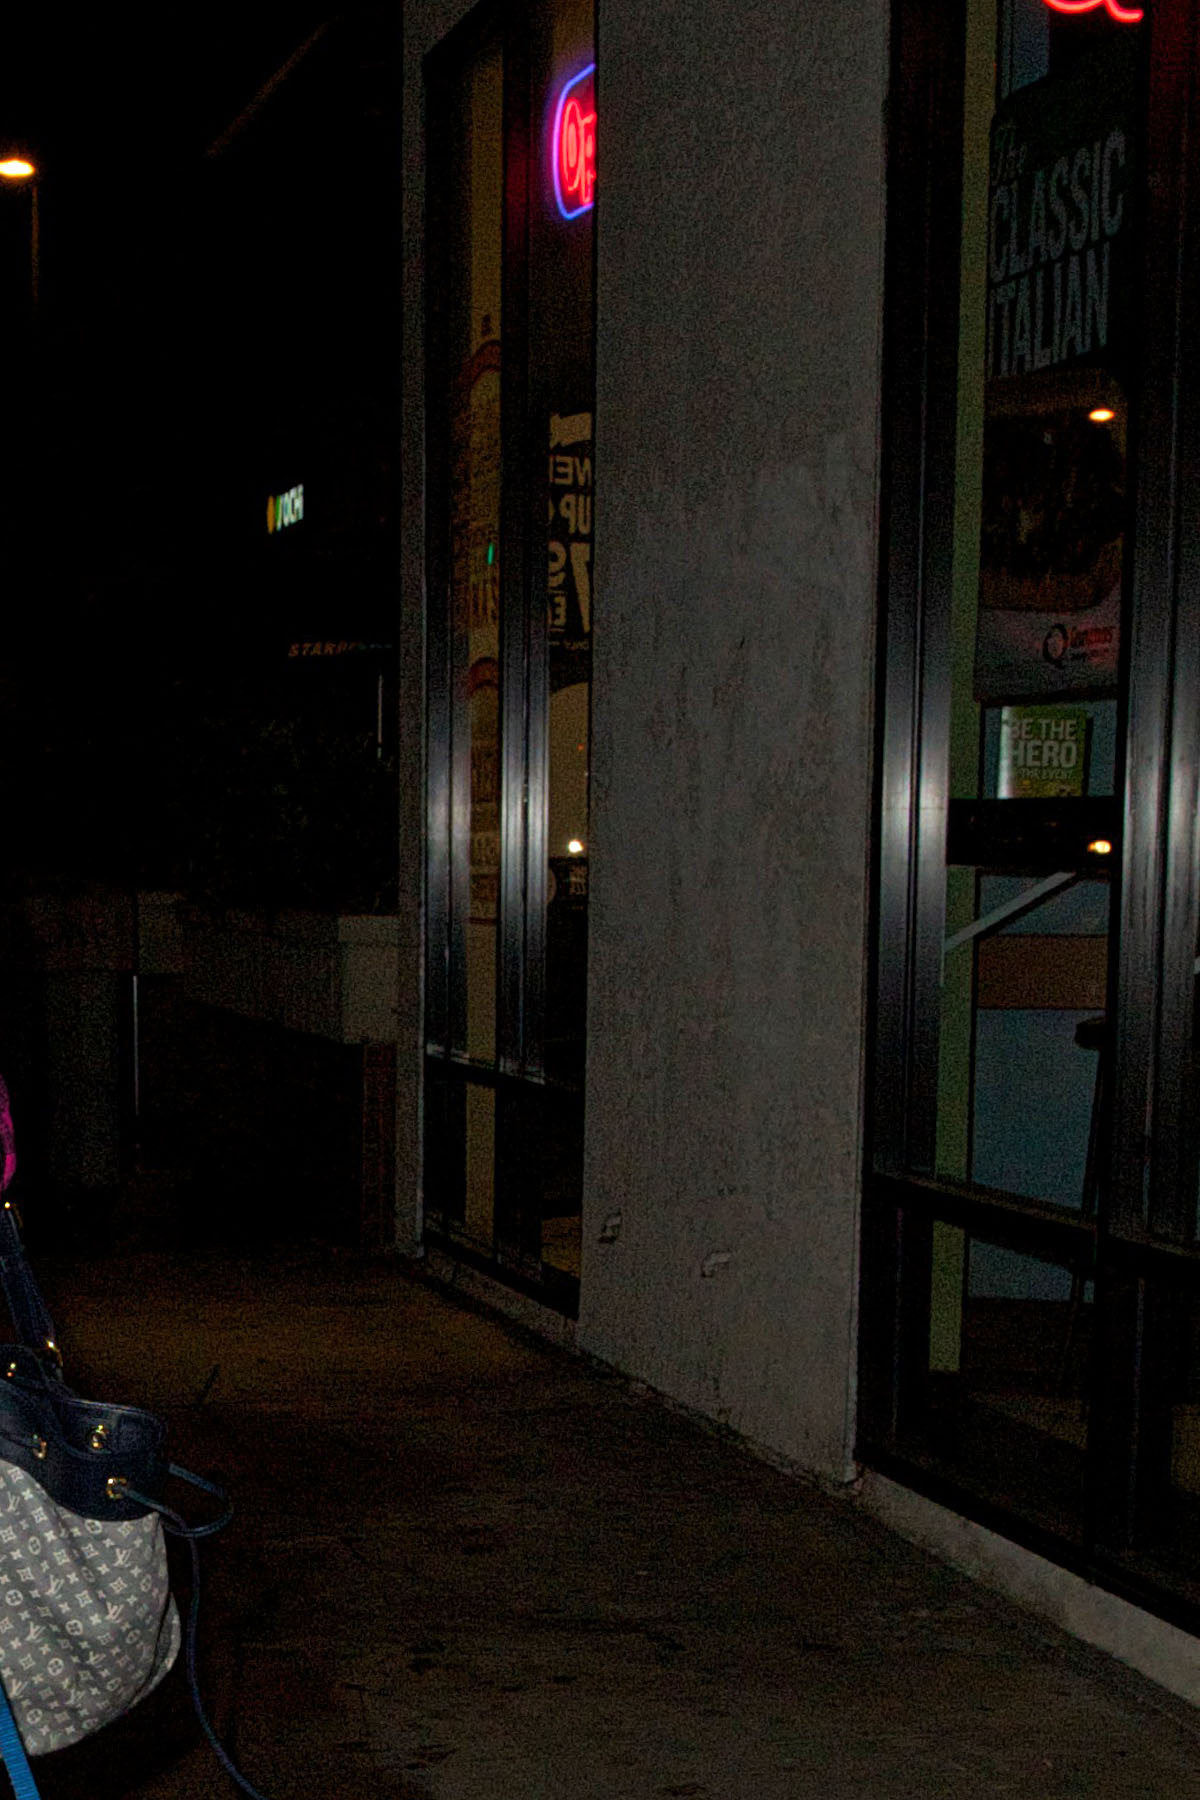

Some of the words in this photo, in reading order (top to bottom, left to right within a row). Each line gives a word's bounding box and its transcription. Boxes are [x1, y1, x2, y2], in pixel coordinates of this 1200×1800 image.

[990, 130, 1127, 283] CLASSIC
[988, 240, 1112, 377] ITALIAN
[1009, 740, 1078, 768] HERO
[1040, 718, 1077, 740] THE
